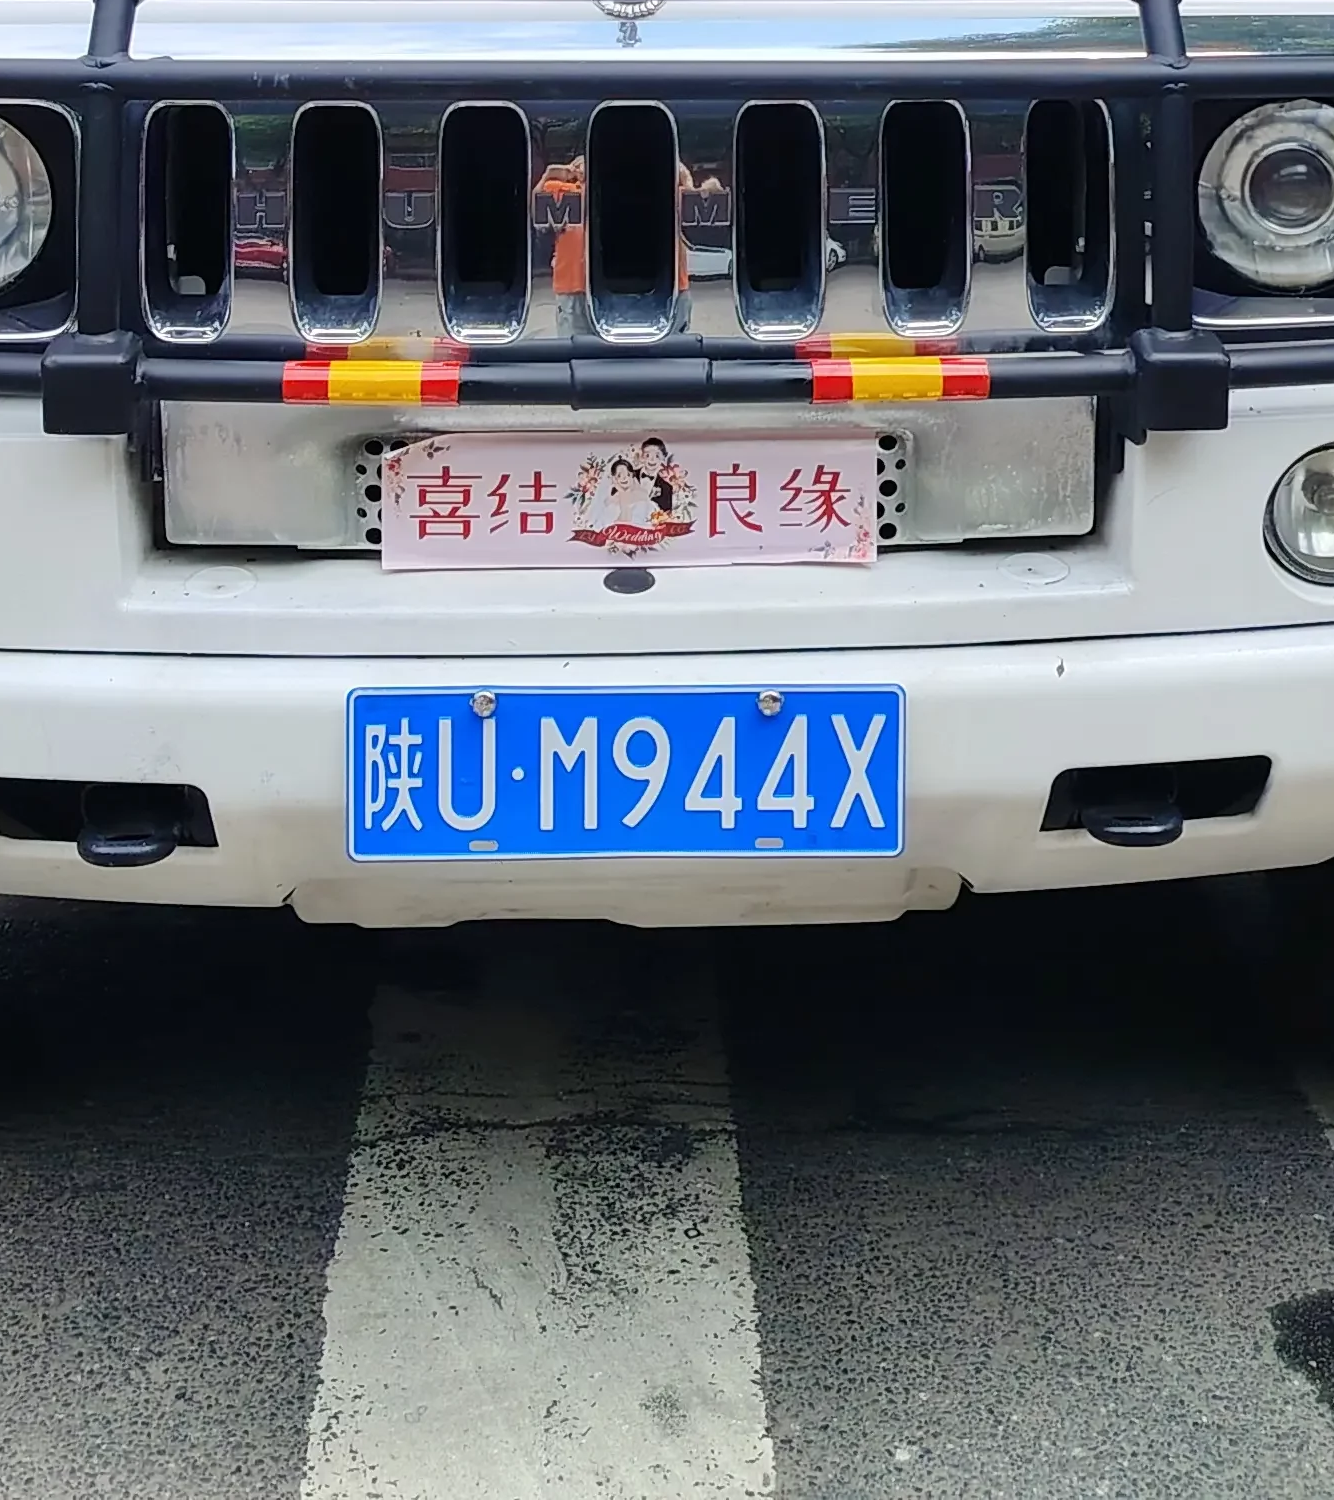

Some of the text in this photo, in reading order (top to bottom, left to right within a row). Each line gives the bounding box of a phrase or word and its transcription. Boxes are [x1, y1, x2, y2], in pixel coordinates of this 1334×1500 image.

[236, 189, 1024, 228] HUMMER
[406, 463, 852, 540] 喜结 良缘
[602, 525, 663, 544] Wedding
[364, 713, 887, 832] 陕U·M944X
